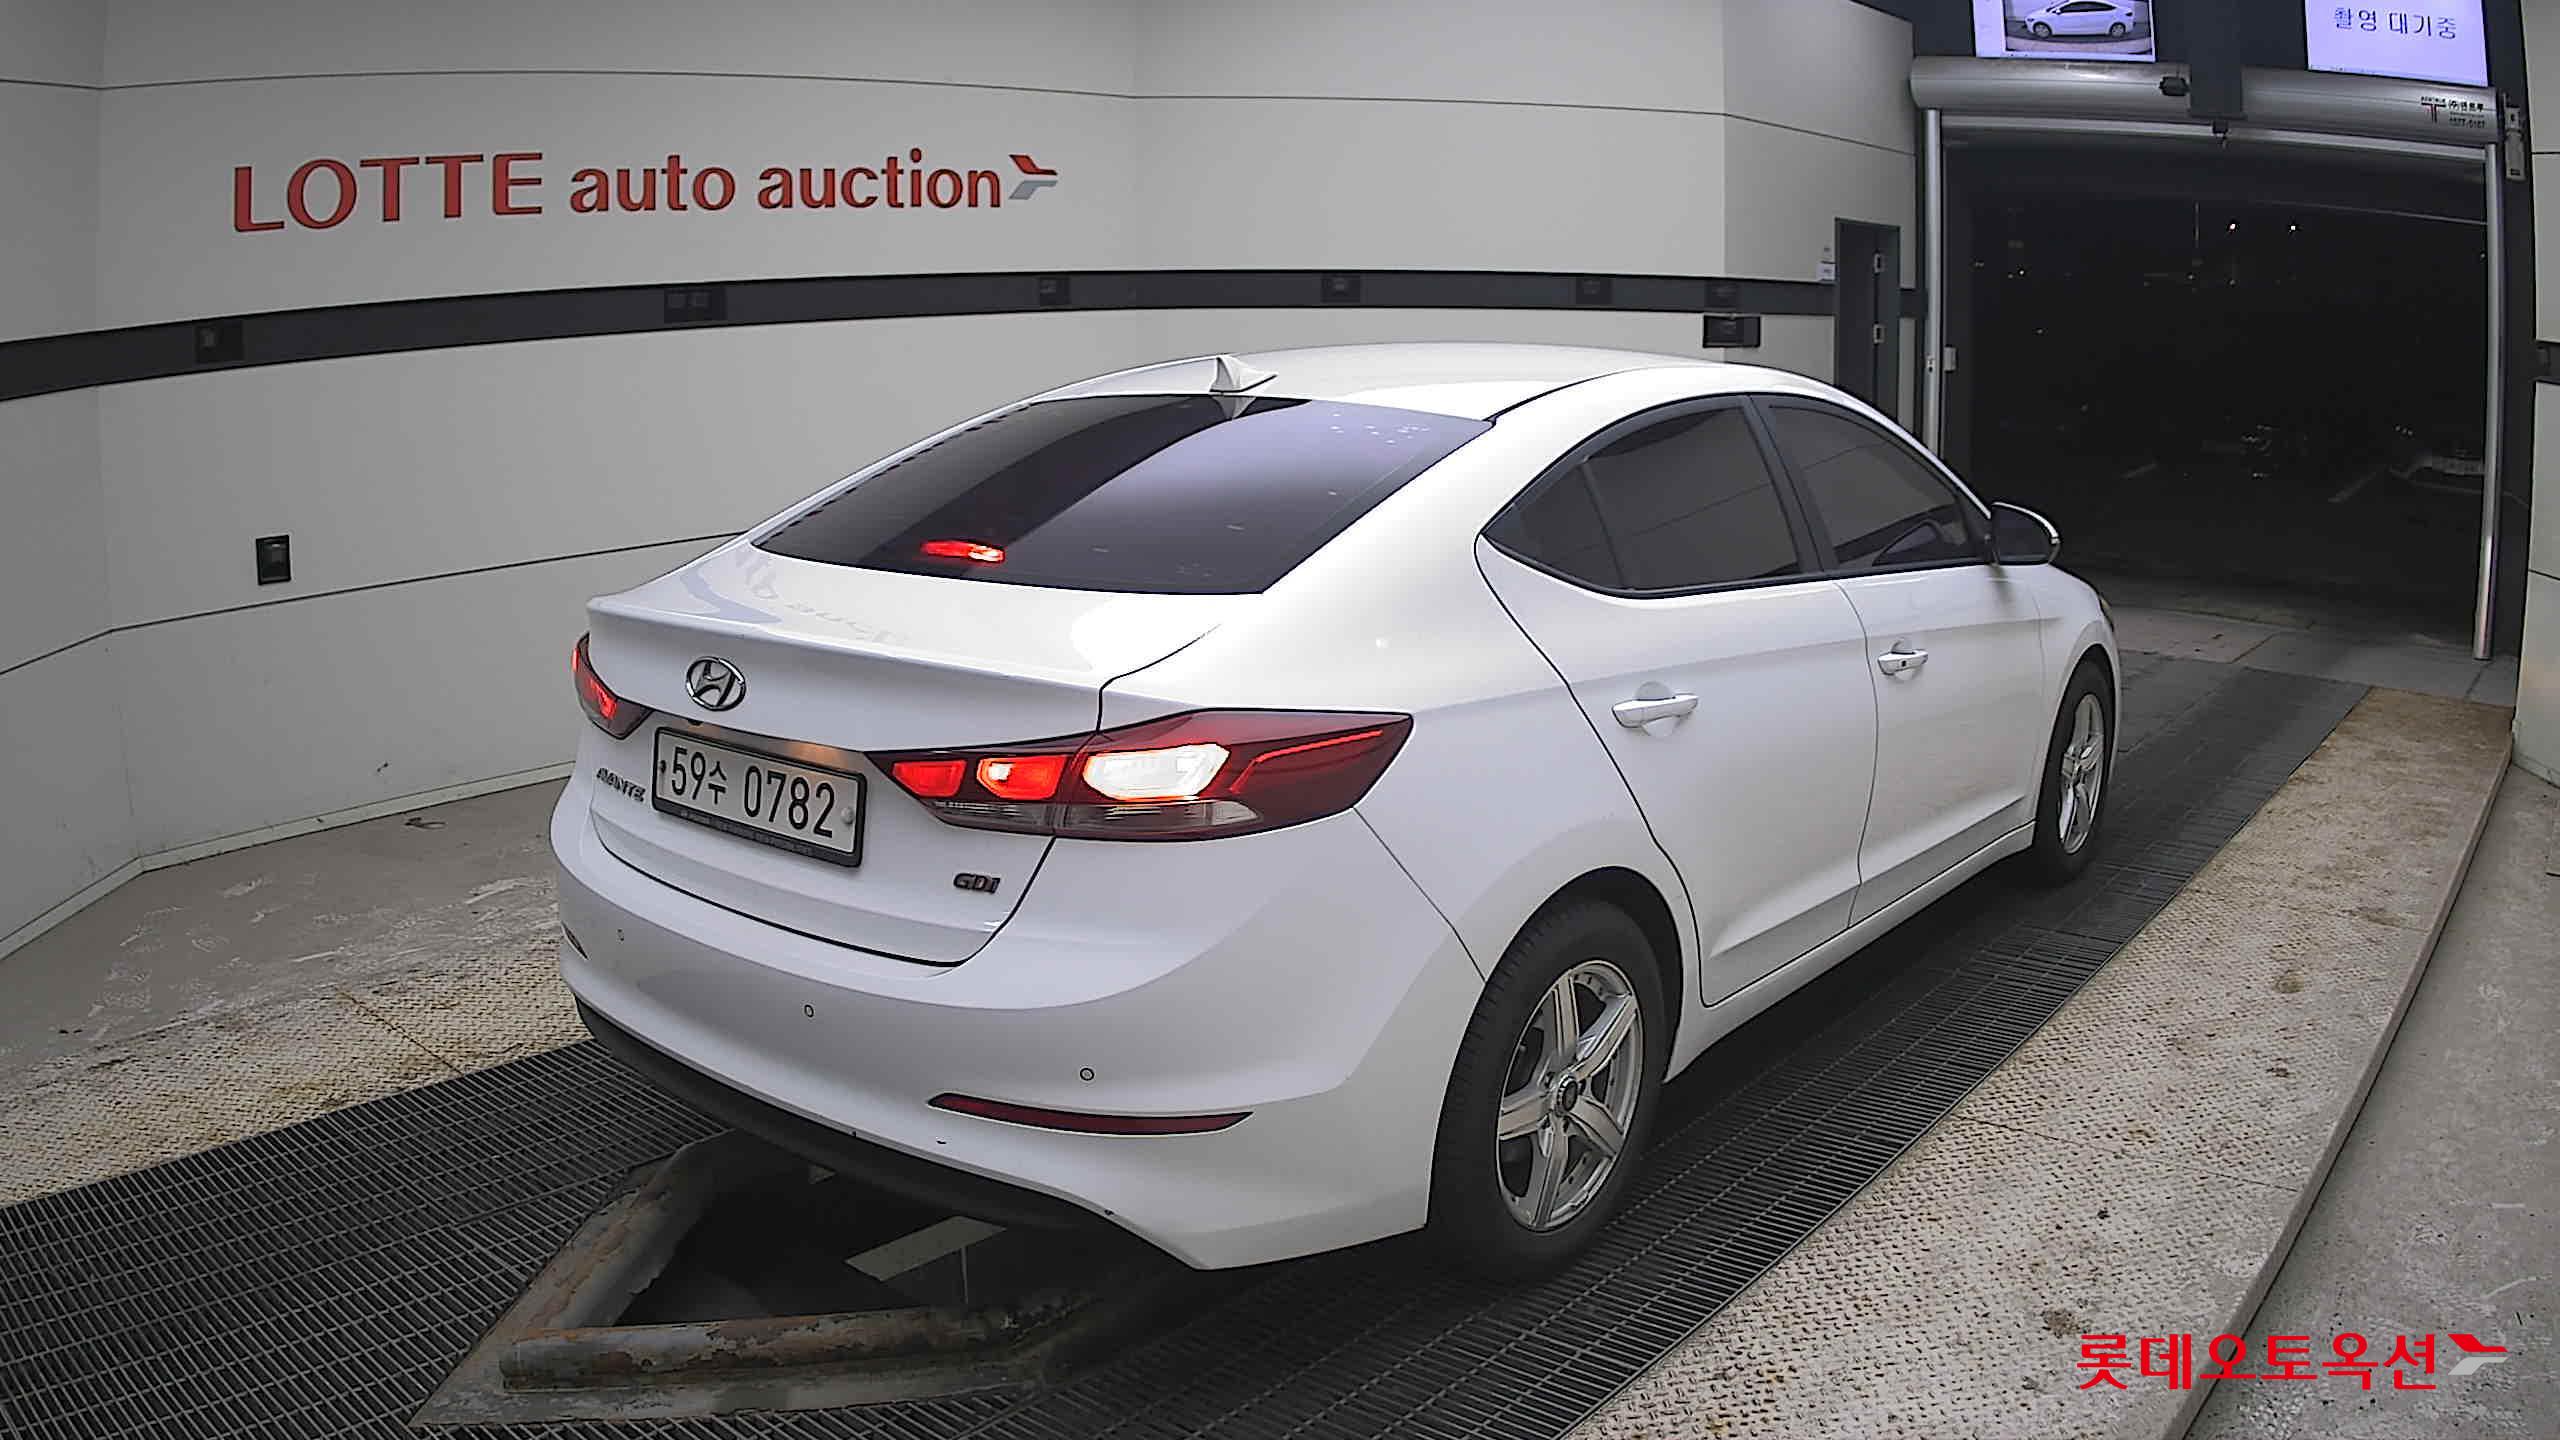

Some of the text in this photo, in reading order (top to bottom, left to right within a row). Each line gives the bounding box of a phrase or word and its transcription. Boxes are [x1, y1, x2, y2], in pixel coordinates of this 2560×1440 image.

[2388, 12, 2457, 40] 대기중
[233, 148, 1002, 233] LOTTE auto auction
[595, 766, 647, 803] AVANTE
[671, 745, 729, 806] 59수
[743, 765, 836, 839] 0782
[953, 872, 1001, 895] GDI
